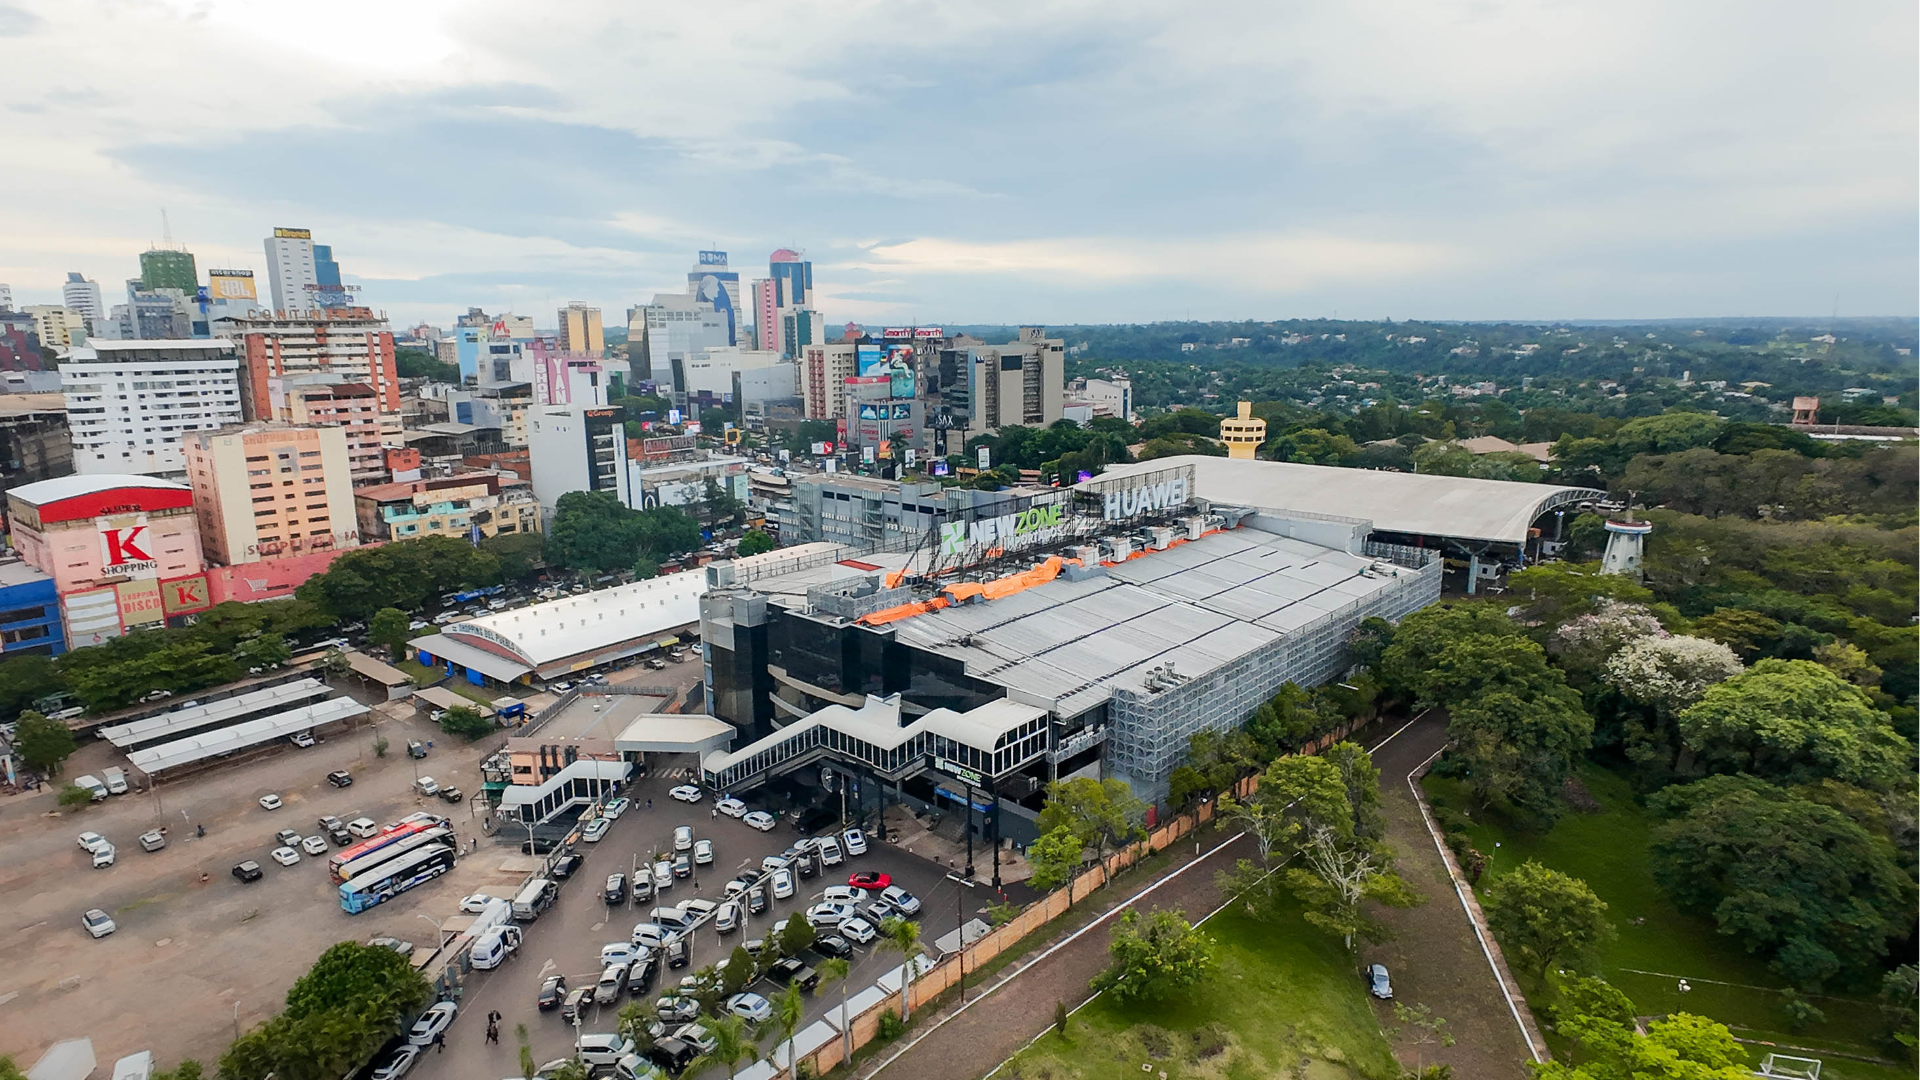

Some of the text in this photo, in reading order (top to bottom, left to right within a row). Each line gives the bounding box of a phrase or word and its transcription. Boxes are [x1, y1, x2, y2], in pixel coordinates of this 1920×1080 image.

[219, 279, 249, 297] JBL
[535, 363, 549, 404] SHOP
[552, 358, 567, 404] YAN
[937, 415, 954, 425] SAX
[1105, 477, 1188, 522] HUAWEI
[101, 525, 155, 566] K
[1004, 526, 1063, 549] IMPORTADOS
[101, 561, 158, 576] SHOPPING
[124, 598, 160, 613] DISCO
[176, 585, 200, 605] K
[459, 623, 484, 637] SHOPPING
[484, 629, 495, 641] DEL
[495, 634, 515, 651] PUEBLO
